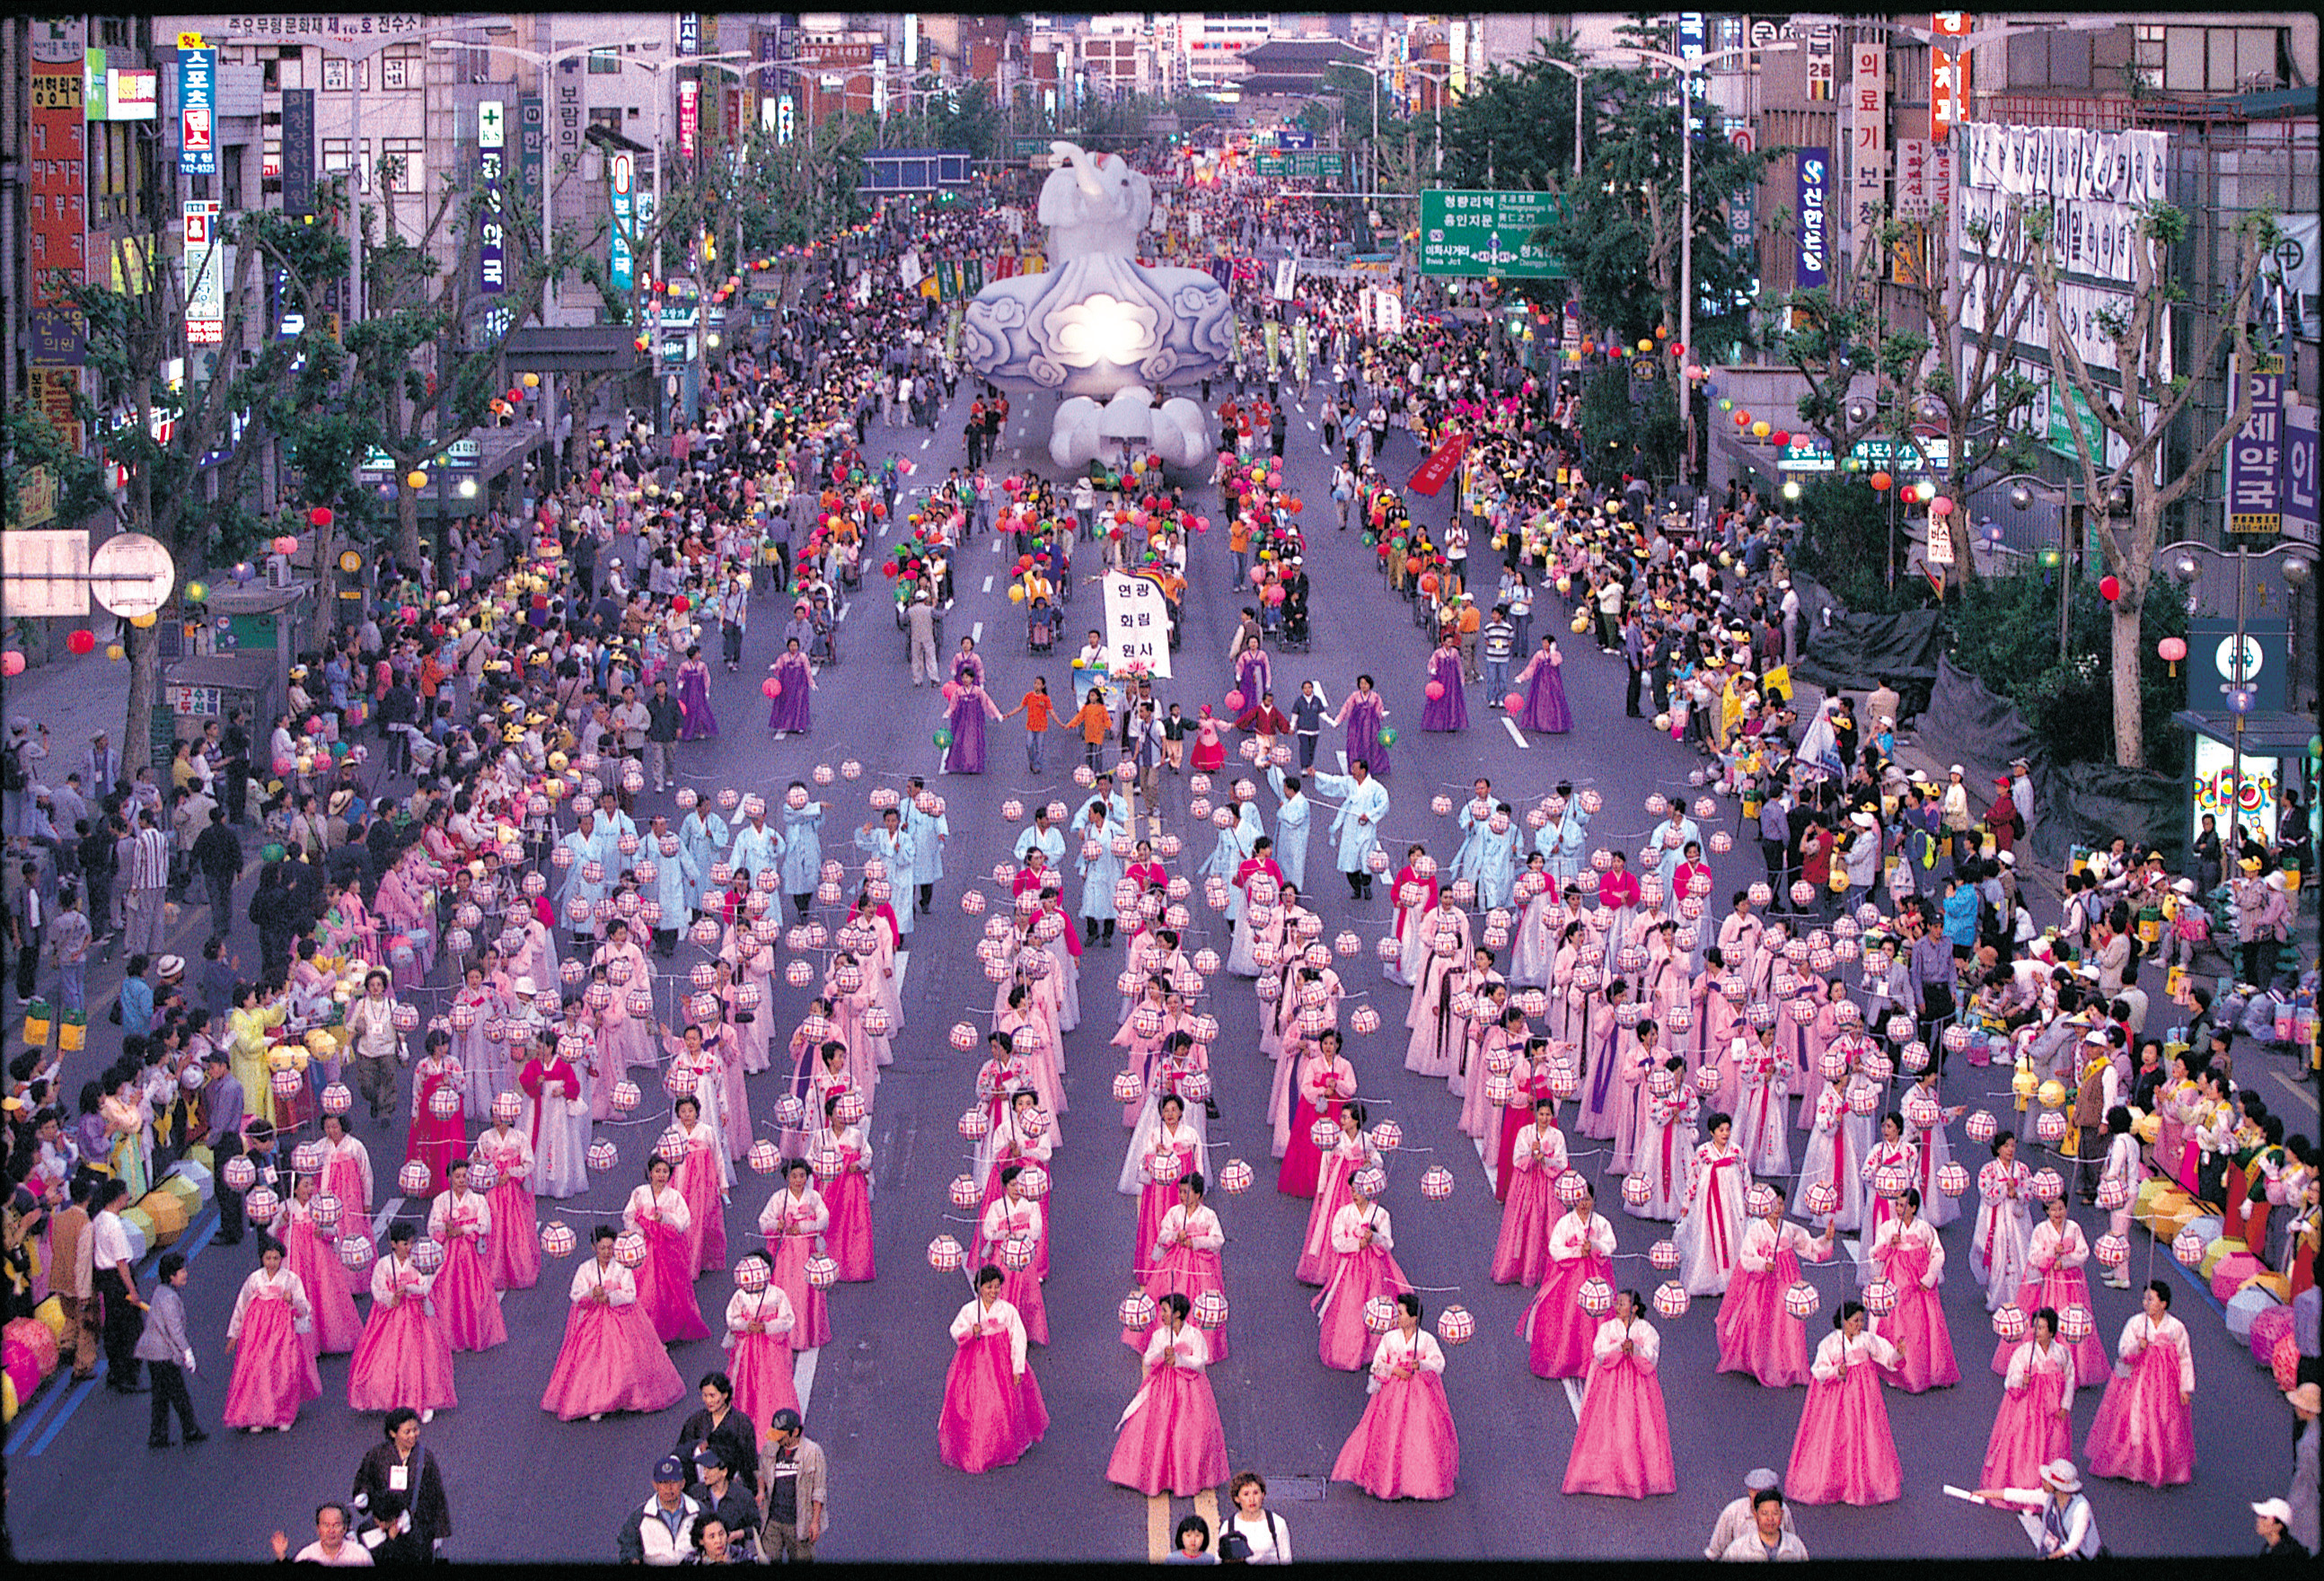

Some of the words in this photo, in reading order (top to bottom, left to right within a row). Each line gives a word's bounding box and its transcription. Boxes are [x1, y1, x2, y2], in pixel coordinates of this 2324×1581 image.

[184, 50, 209, 108] 스포츠
[1809, 63, 1831, 78] 2층
[1859, 53, 1879, 150] 의료기
[185, 110, 209, 150] 댄스
[182, 153, 214, 163] 학원
[1444, 194, 1494, 209] 청량리역
[481, 153, 504, 286] 종약국
[1444, 213, 1492, 227] 흥인지문
[1801, 187, 1823, 272] 신한은행
[1425, 244, 1470, 257] 이화사거리
[44, 338, 75, 352] 의원
[2236, 377, 2279, 509] 인제약국
